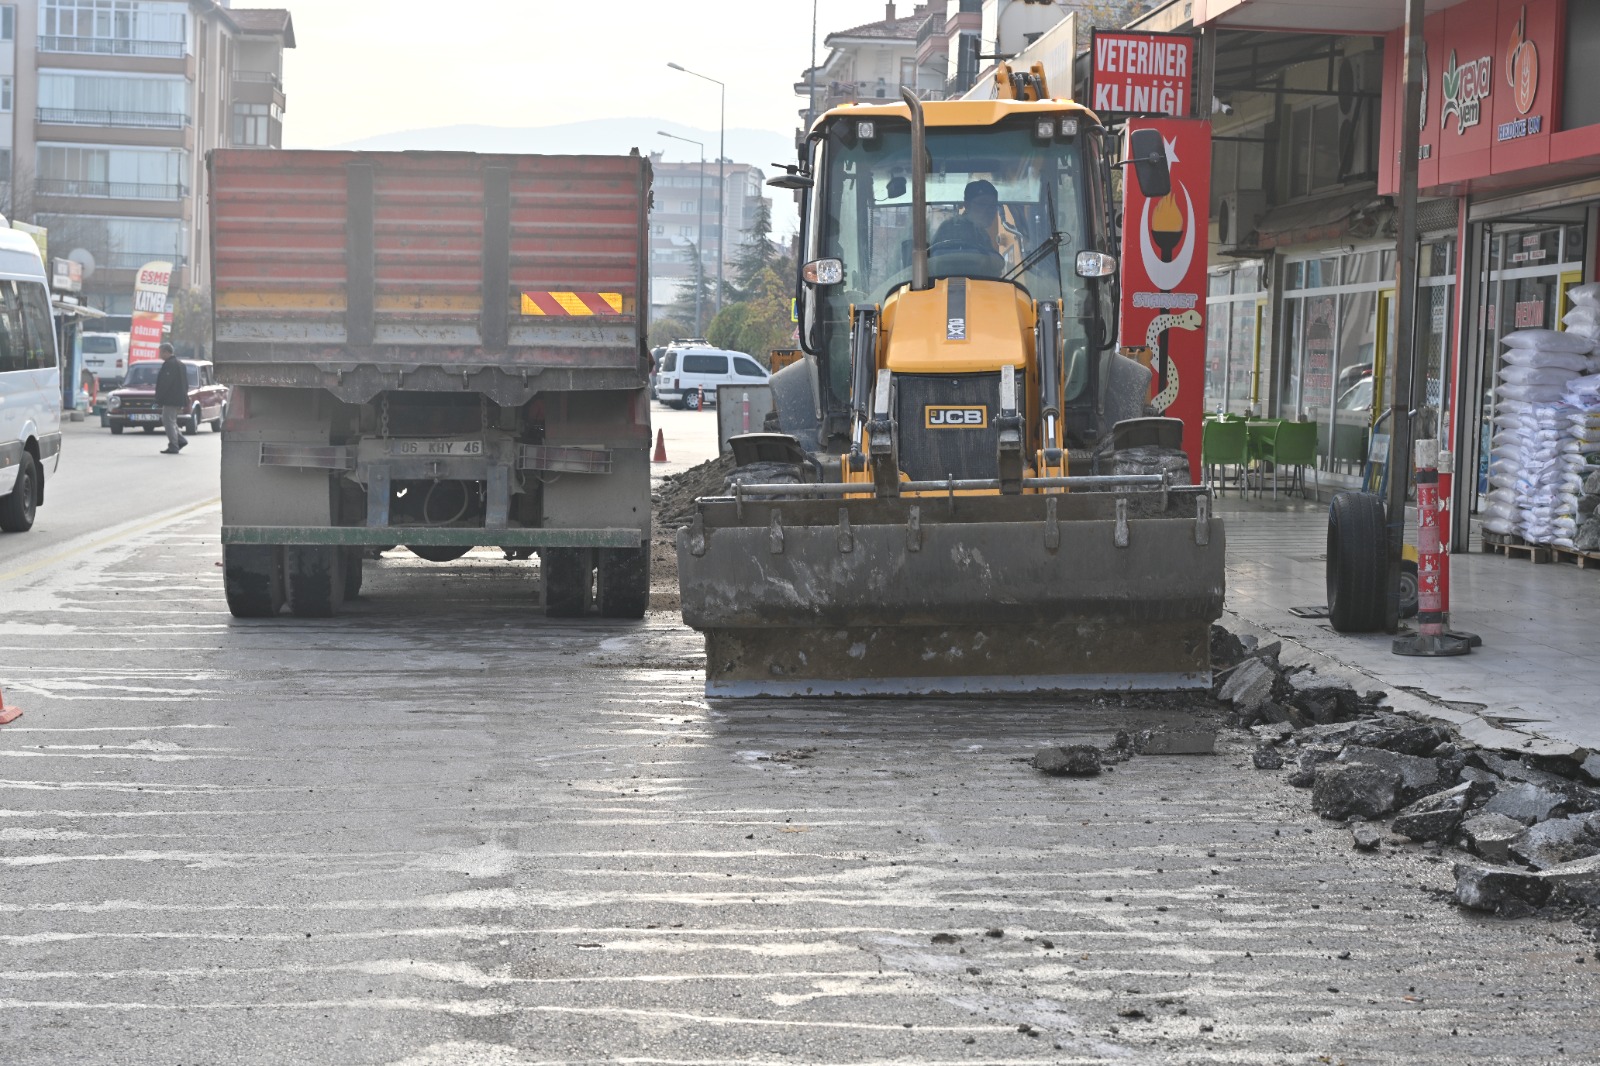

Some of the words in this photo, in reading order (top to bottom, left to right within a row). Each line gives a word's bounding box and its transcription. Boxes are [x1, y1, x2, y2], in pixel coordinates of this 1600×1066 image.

[1096, 36, 1187, 77] VETERİNER
[1095, 78, 1183, 116] KLİNİĞİ
[1458, 103, 1478, 132] yem
[1498, 117, 1527, 141] HEDİYE
[1528, 115, 1541, 134] UN
[140, 270, 170, 286] ESME
[135, 291, 166, 313] KATMER
[1133, 292, 1198, 309] STARVET
[931, 410, 982, 424] JCB
[402, 442, 418, 453] 06
[428, 442, 453, 453] KHY
[463, 442, 479, 453] 46
